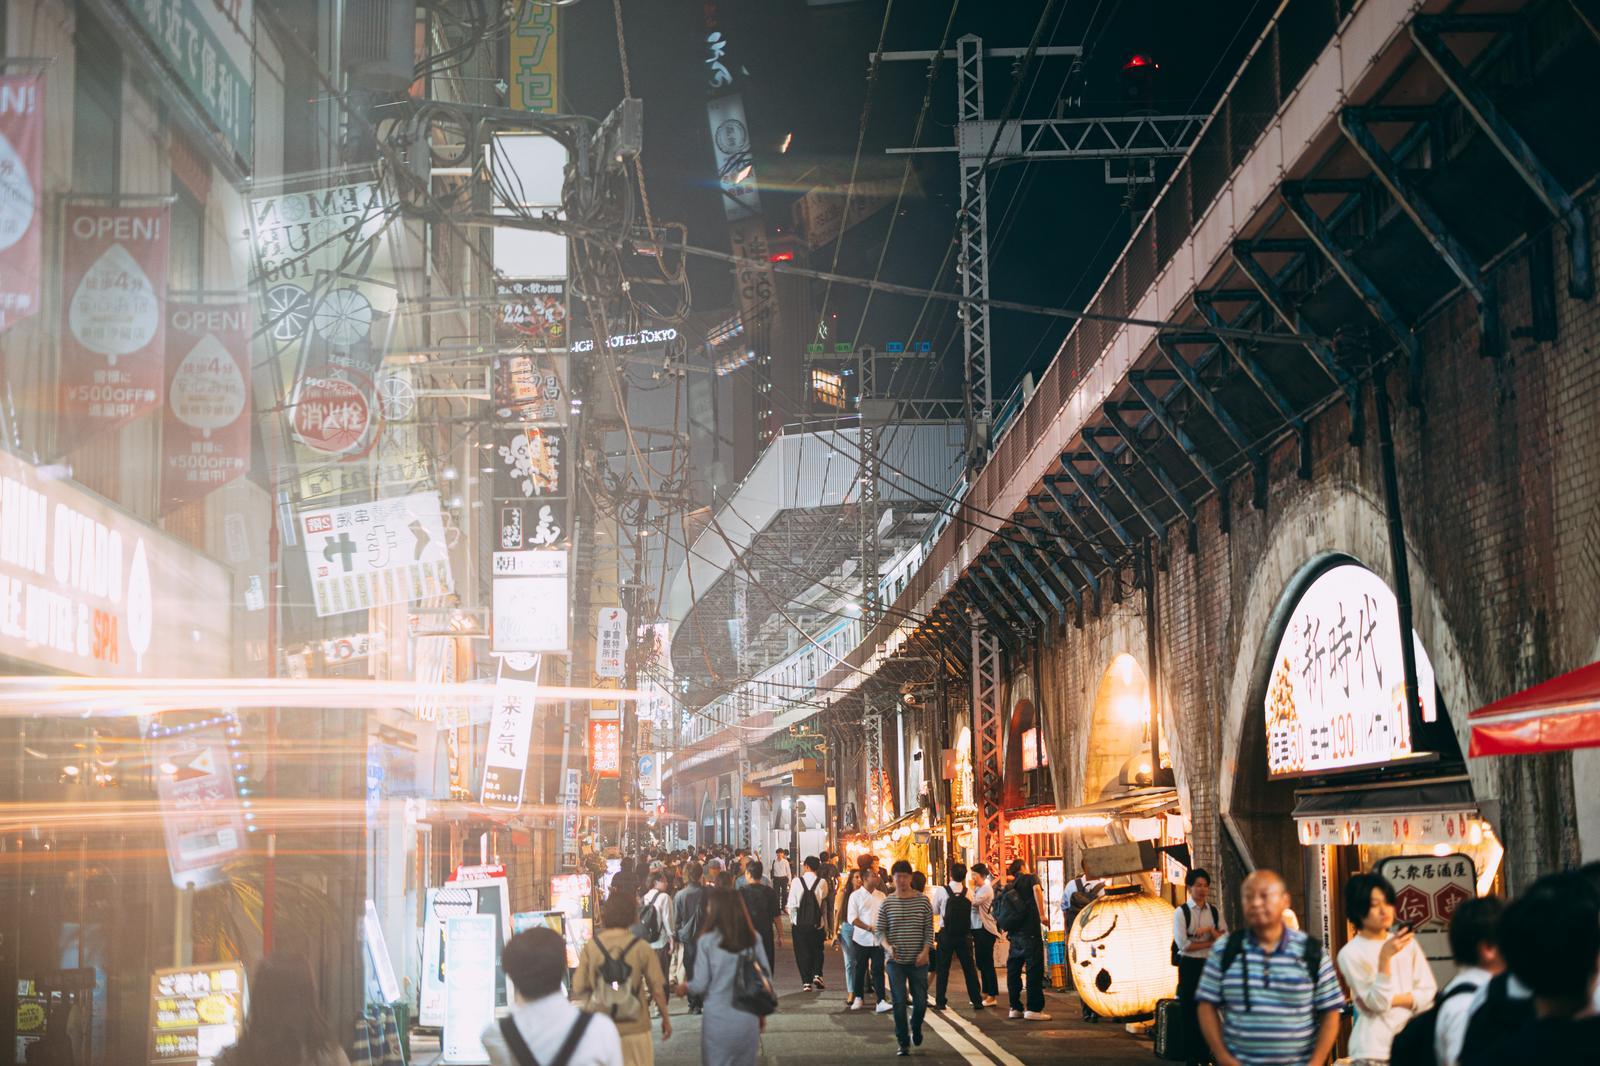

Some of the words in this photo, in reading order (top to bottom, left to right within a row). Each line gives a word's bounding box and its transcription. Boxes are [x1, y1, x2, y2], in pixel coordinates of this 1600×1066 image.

[72, 215, 161, 241] OPEN!
[172, 311, 247, 330] OPEN!
[640, 328, 677, 344] TOKYO
[1302, 593, 1383, 708] 新時代
[1391, 861, 1468, 881] 大衆居酒屋
[1400, 895, 1425, 920] 伝
